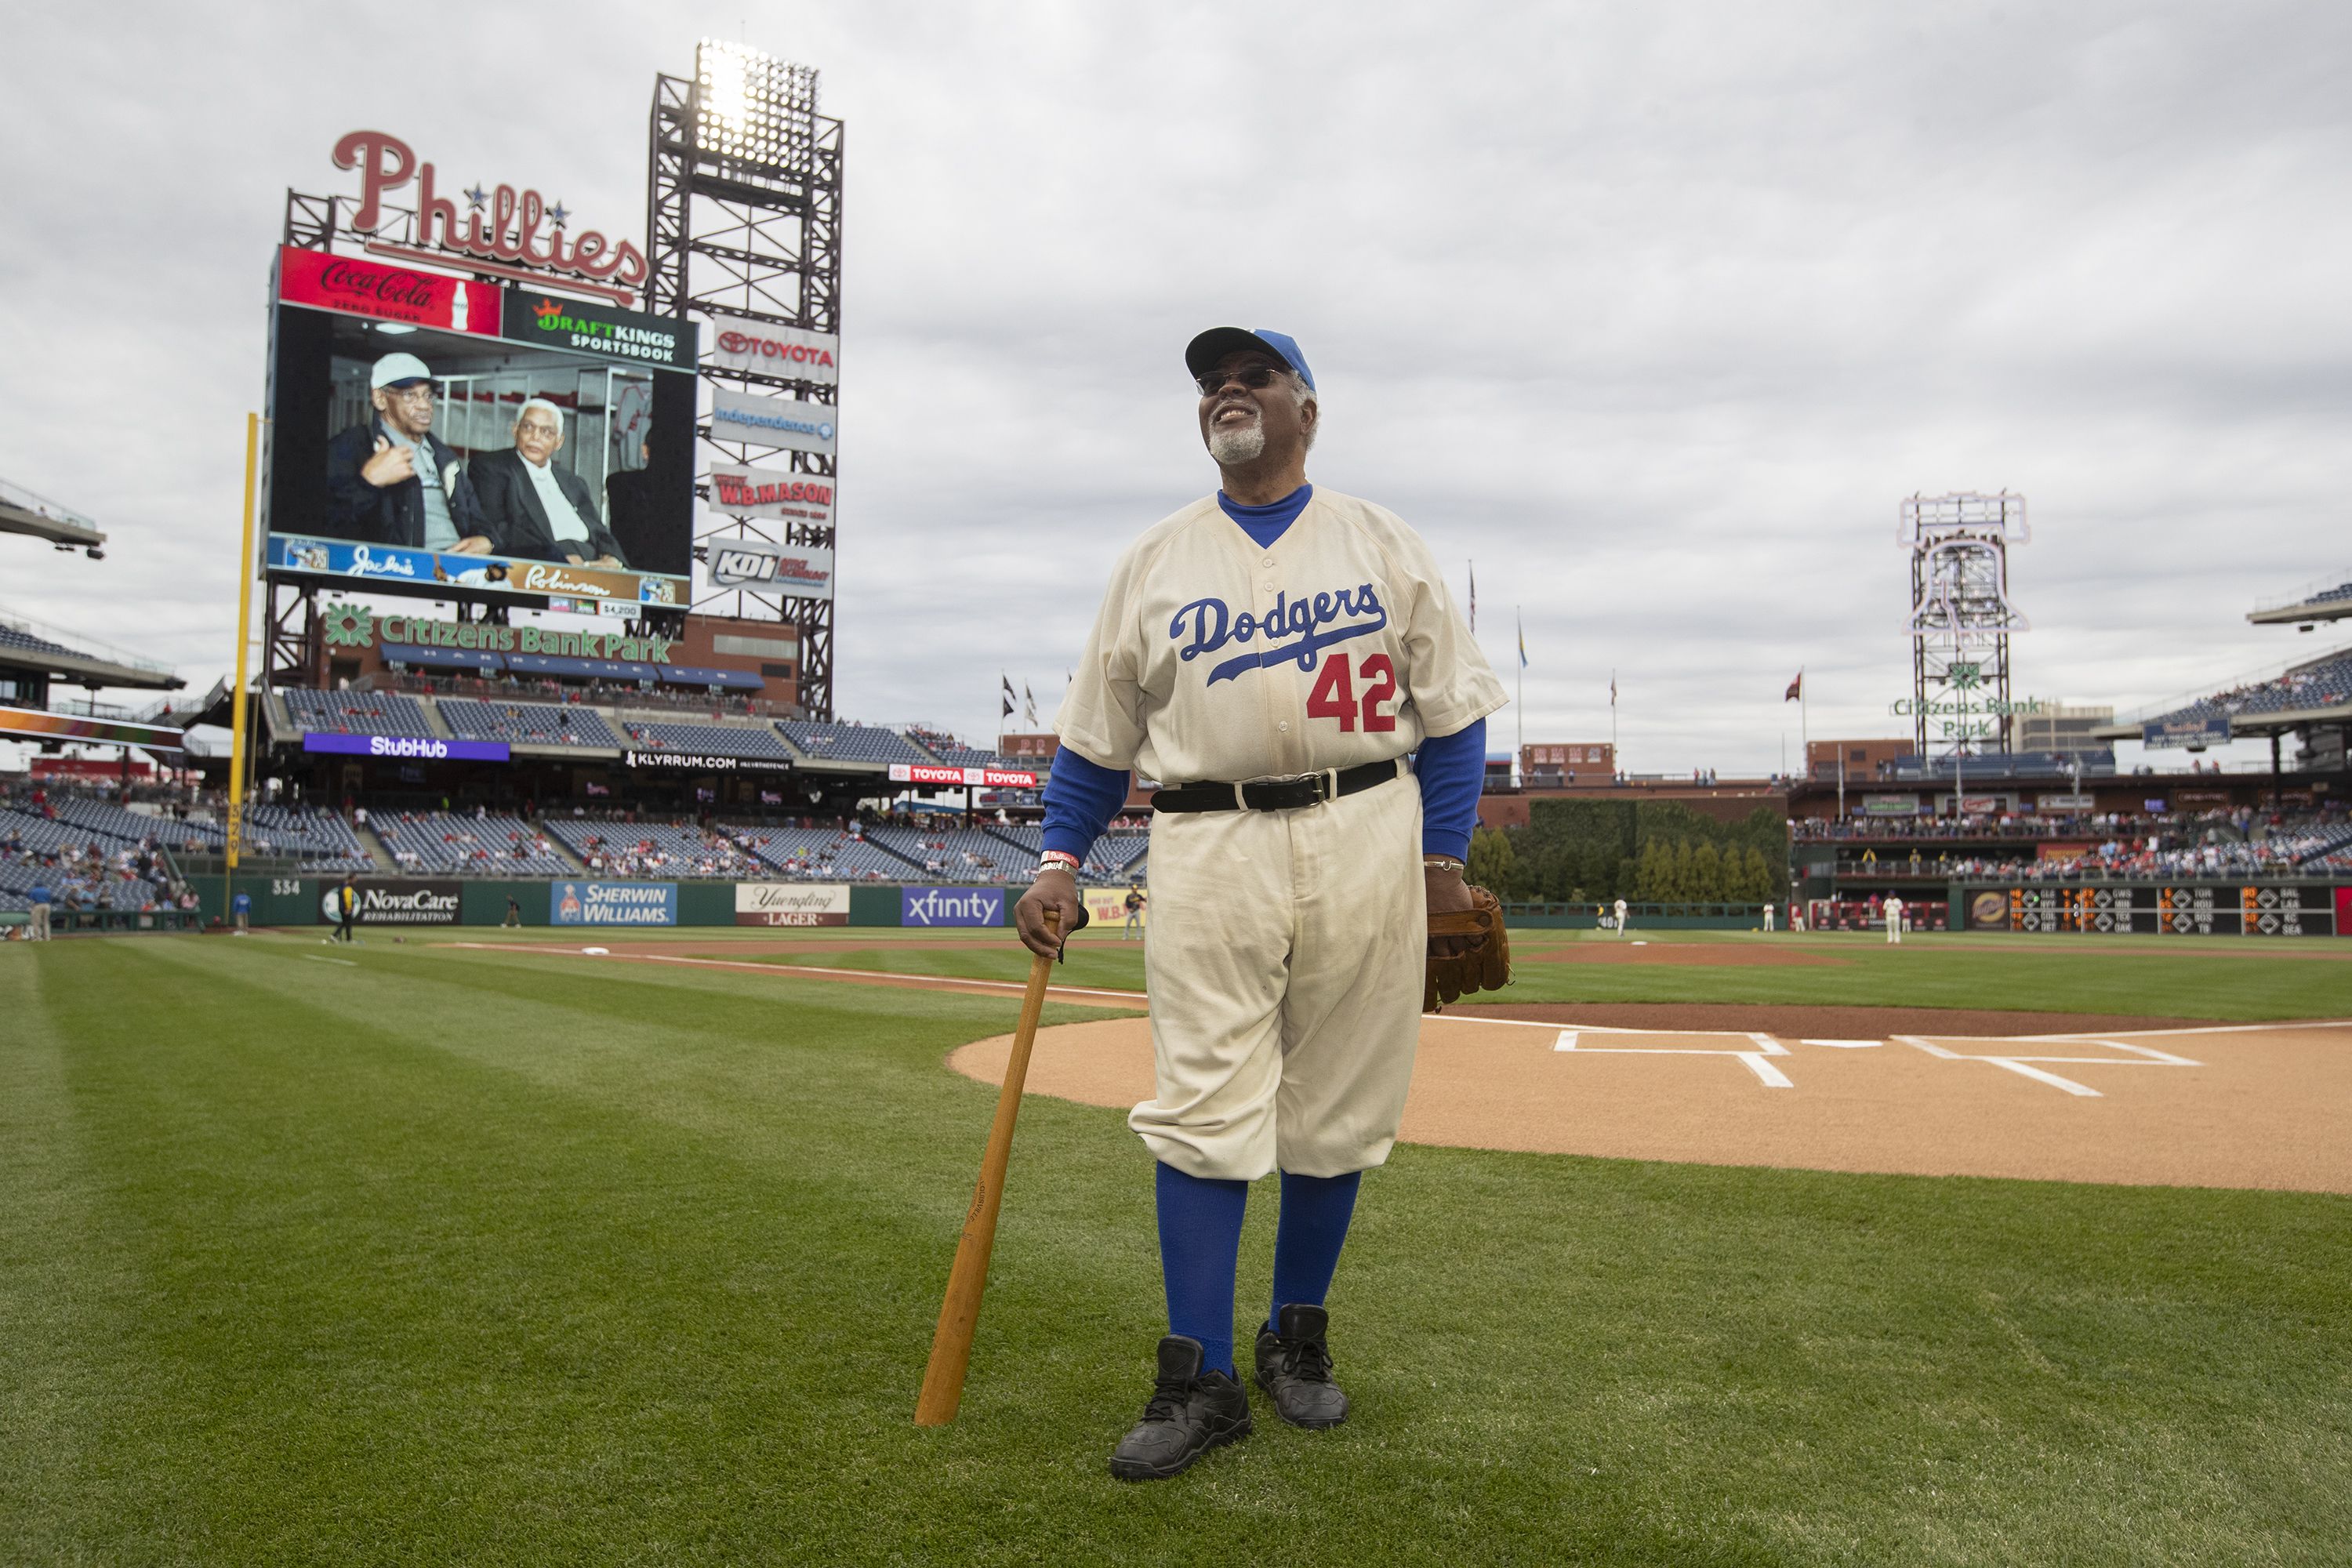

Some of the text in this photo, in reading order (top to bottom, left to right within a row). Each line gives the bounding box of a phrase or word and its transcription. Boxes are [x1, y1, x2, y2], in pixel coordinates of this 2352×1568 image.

[332, 130, 649, 288] Phillies
[536, 314, 676, 349] DRAFTKINGS
[571, 333, 674, 362] SPORTSBOOK
[749, 336, 834, 368] TOYOTA
[714, 407, 816, 434] Independence
[347, 544, 416, 577] Jackie
[714, 550, 779, 583] KDI
[524, 564, 611, 597] Robinson
[604, 604, 637, 617] $4,200
[381, 615, 515, 653] Citizens
[520, 626, 600, 659] Bank
[604, 633, 672, 665] Park
[1169, 583, 1387, 674] Dodgers
[1306, 652, 1396, 733] 42
[1893, 695, 2040, 716] Citizens Bank
[1943, 720, 1990, 737] Park
[370, 735, 448, 758] StubHub
[637, 753, 737, 769] KLYRRUM.COM
[913, 768, 962, 782] TOYOTA
[985, 772, 1033, 785] TOYOTA
[272, 879, 300, 895] 334
[362, 888, 459, 910] NovaCare
[584, 884, 667, 904] SHERWIN
[750, 885, 837, 911] Yuengling
[362, 911, 454, 922] REHABILITATION
[909, 889, 999, 925] xfinity
[768, 913, 818, 926] LAGER
[2281, 924, 2303, 936] SEA
